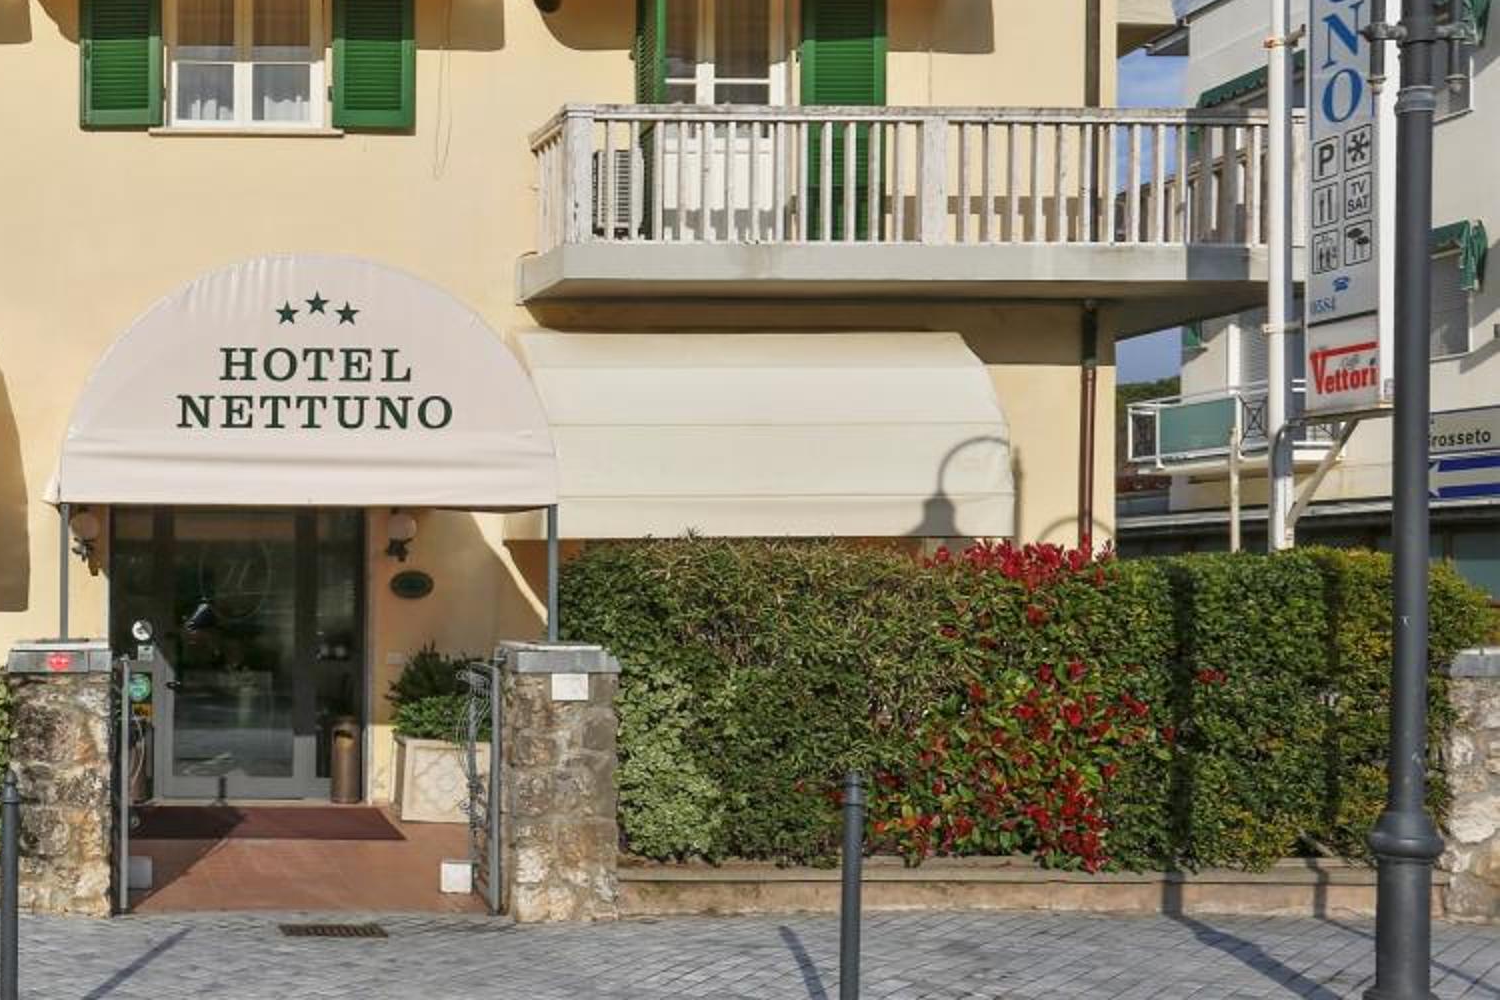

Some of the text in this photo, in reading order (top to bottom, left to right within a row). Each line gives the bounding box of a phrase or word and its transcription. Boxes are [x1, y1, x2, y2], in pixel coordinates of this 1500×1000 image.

[1318, 144, 1334, 176] P
[1351, 179, 1367, 195] TV
[1347, 196, 1369, 213] SAT
[219, 347, 411, 382] HOTEL
[1309, 341, 1379, 395] Vettori
[176, 394, 453, 429] NETTUNO
[1428, 429, 1492, 447] rosseto
